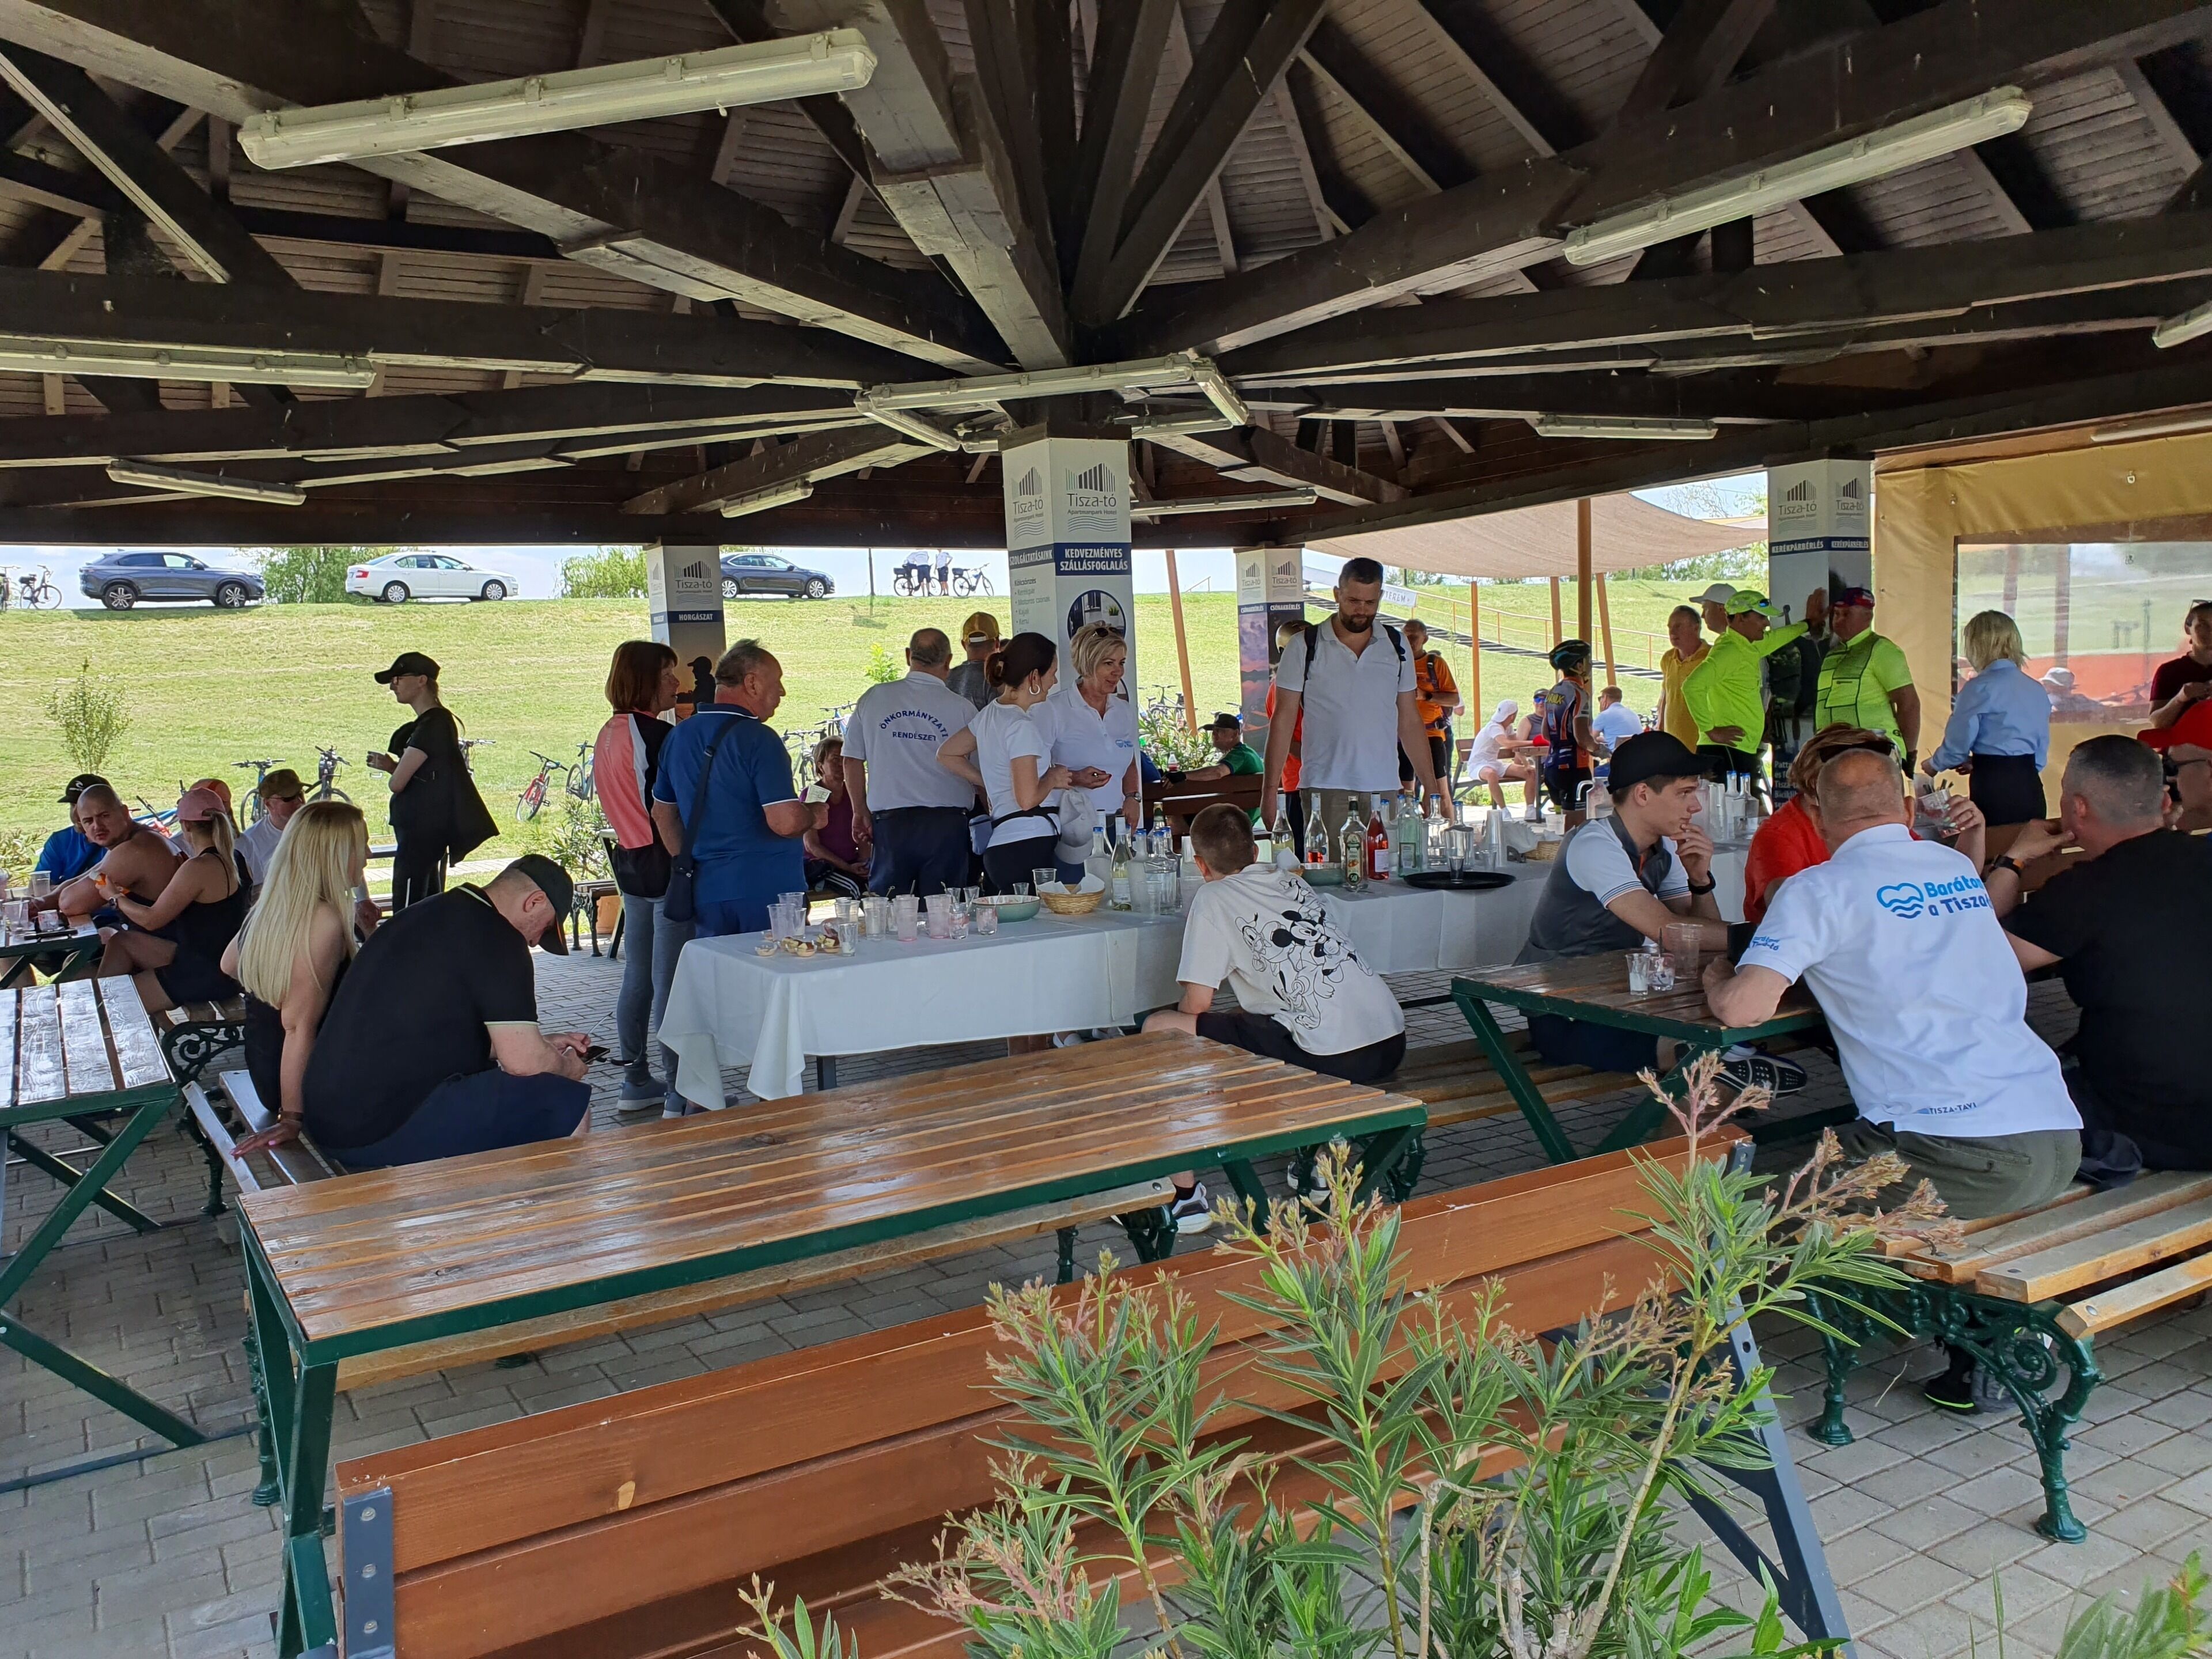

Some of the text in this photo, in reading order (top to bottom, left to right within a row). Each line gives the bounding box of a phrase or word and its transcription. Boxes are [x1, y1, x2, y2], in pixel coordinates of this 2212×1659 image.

[1013, 496, 1044, 514] Tisza-tó
[1066, 493, 1117, 507] Tisza-tó
[1836, 499, 1864, 510] Tisza-tó
[1778, 501, 1817, 516] Tisza-tó
[1009, 549, 1053, 566] SZOLGÁLTATÁSAINK
[1065, 547, 1123, 558] KEDVEZMÉNYES
[1060, 559, 1128, 571] SZÁLLÁSFOGLALÁS
[675, 579, 713, 589] Tisza-tó
[1272, 575, 1297, 584] Tisza-tó
[1383, 589, 1406, 603] TEREM
[679, 612, 713, 621] HORGÁSZAT
[879, 710, 949, 738] ÖNKORMÁNYZATI
[892, 731, 936, 741] RENDÉSZET
[1928, 904, 1939, 916] a
